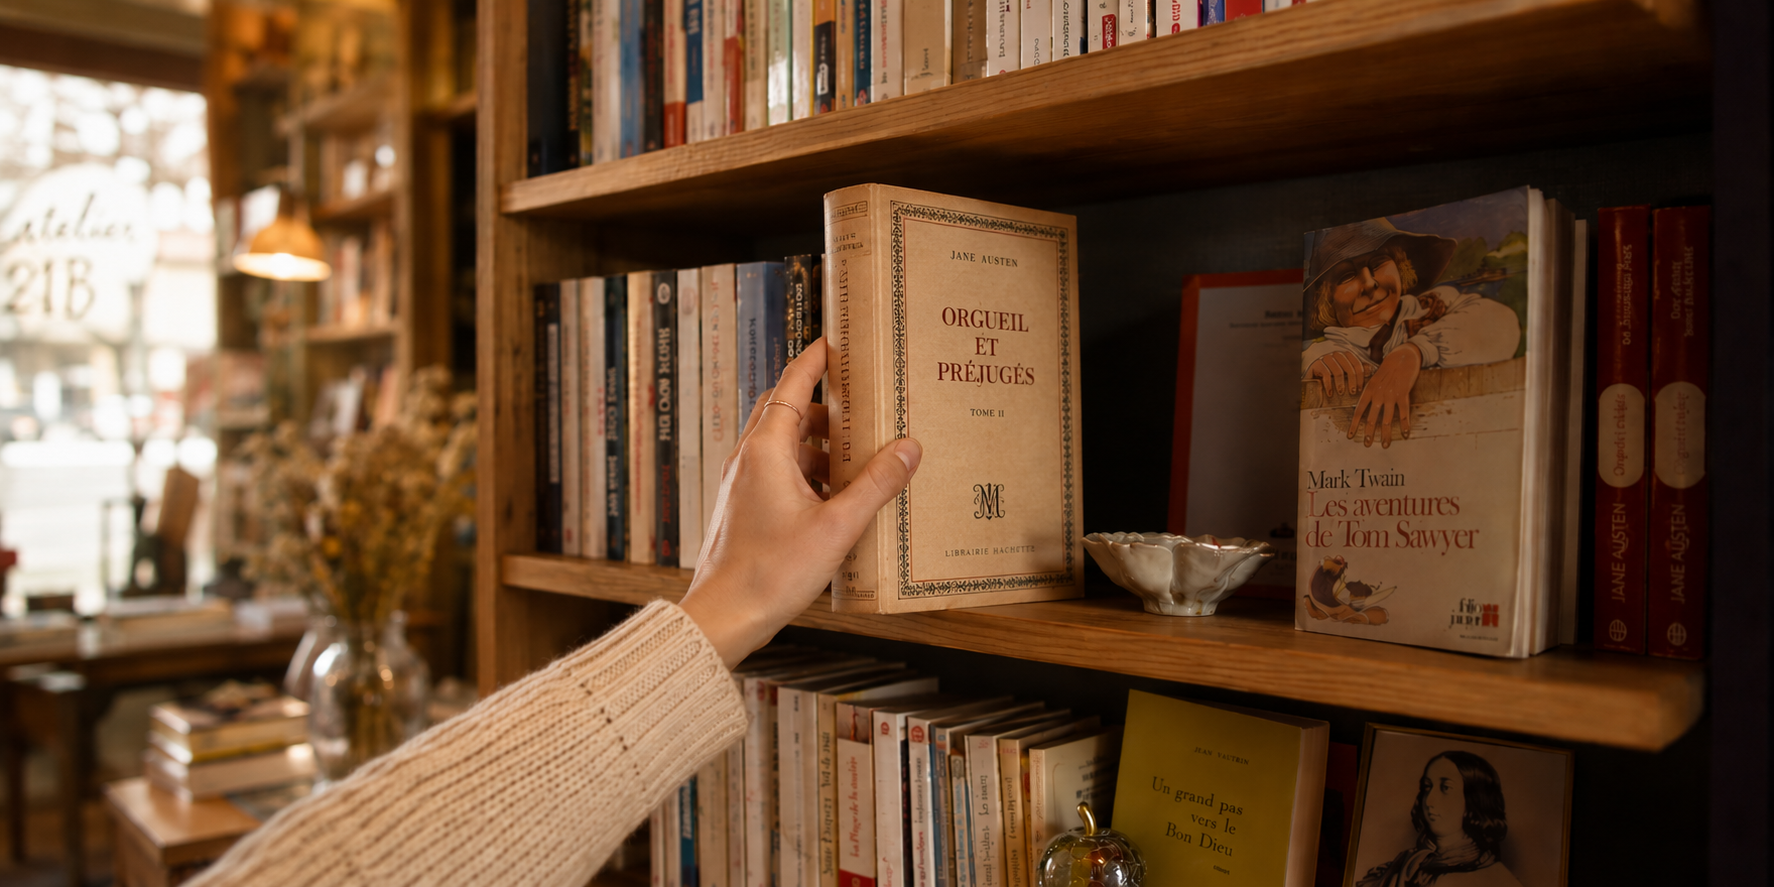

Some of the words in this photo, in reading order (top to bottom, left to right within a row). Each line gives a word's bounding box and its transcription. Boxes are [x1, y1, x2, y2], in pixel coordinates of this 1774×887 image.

[950, 250, 976, 262] JANE
[981, 255, 1018, 267] AUSTEN
[3, 256, 96, 321] 21B
[942, 306, 1029, 332] ORGUEIL
[975, 337, 999, 356] ET
[937, 360, 1036, 387] PRÉJUGÉS
[970, 408, 995, 417] TOME
[1306, 470, 1351, 489] Mark
[1354, 468, 1405, 488] Twain
[1306, 491, 1348, 518] Les
[1353, 494, 1460, 517] aventures
[1305, 520, 1333, 547] de
[1337, 520, 1390, 548] Tom
[1395, 519, 1480, 556] Sawyer
[1611, 502, 1629, 560] AUSTEN
[1670, 503, 1690, 562] AUSTEN
[945, 547, 989, 557] LIBRAIRIE
[1611, 562, 1626, 604] JANE
[1670, 563, 1686, 604] JANE
[1194, 746, 1213, 756] JEAN
[1151, 776, 1171, 795] Un
[1174, 789, 1215, 807] grand
[1218, 802, 1243, 815] pas
[1190, 813, 1217, 830] vers
[1224, 818, 1236, 835] le
[1165, 821, 1192, 844] Bon
[1199, 832, 1233, 857] Dieu
